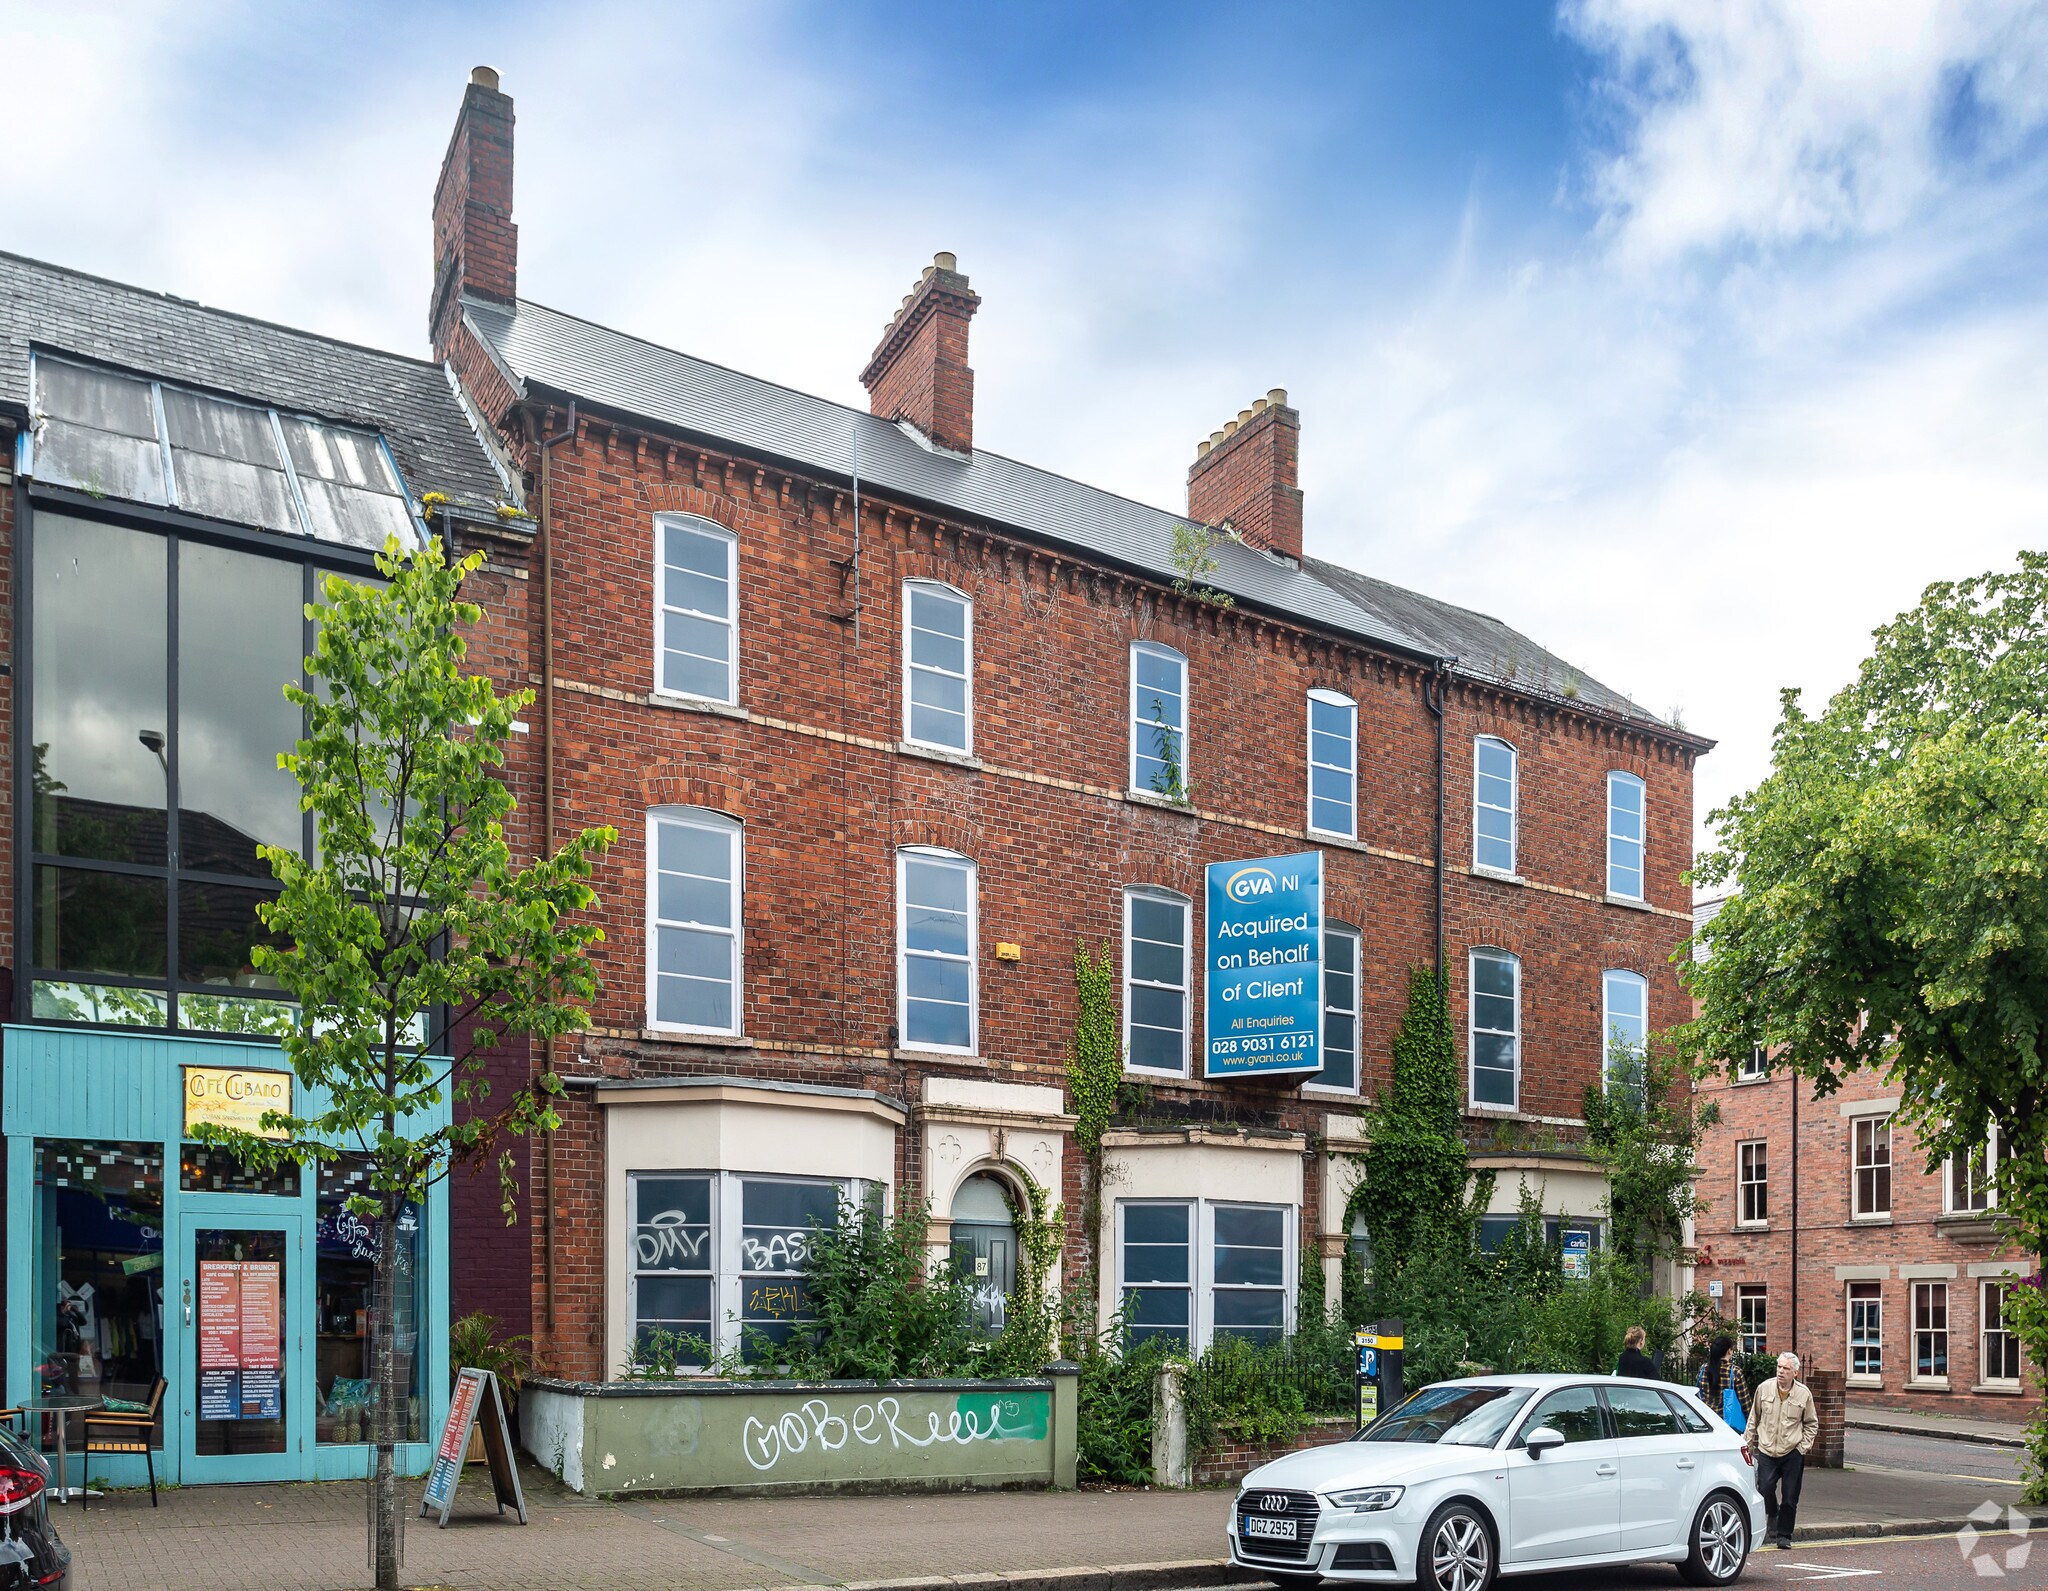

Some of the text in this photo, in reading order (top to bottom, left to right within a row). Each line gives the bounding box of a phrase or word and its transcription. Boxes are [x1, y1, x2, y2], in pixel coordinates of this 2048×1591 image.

[1235, 874, 1298, 896] GVA NI
[1218, 912, 1307, 939] Acquired
[1217, 943, 1309, 970] on Behalf
[1222, 977, 1304, 1002] of Client
[1231, 1015, 1294, 1029] All Enquiries
[1212, 1034, 1314, 1054] 028 9031 6121
[1222, 1051, 1303, 1066] www.gvani.co.uk
[337, 1212, 369, 1244] Coffee
[976, 1262, 987, 1271] 87
[1251, 1518, 1295, 1537] DGZ 2952
